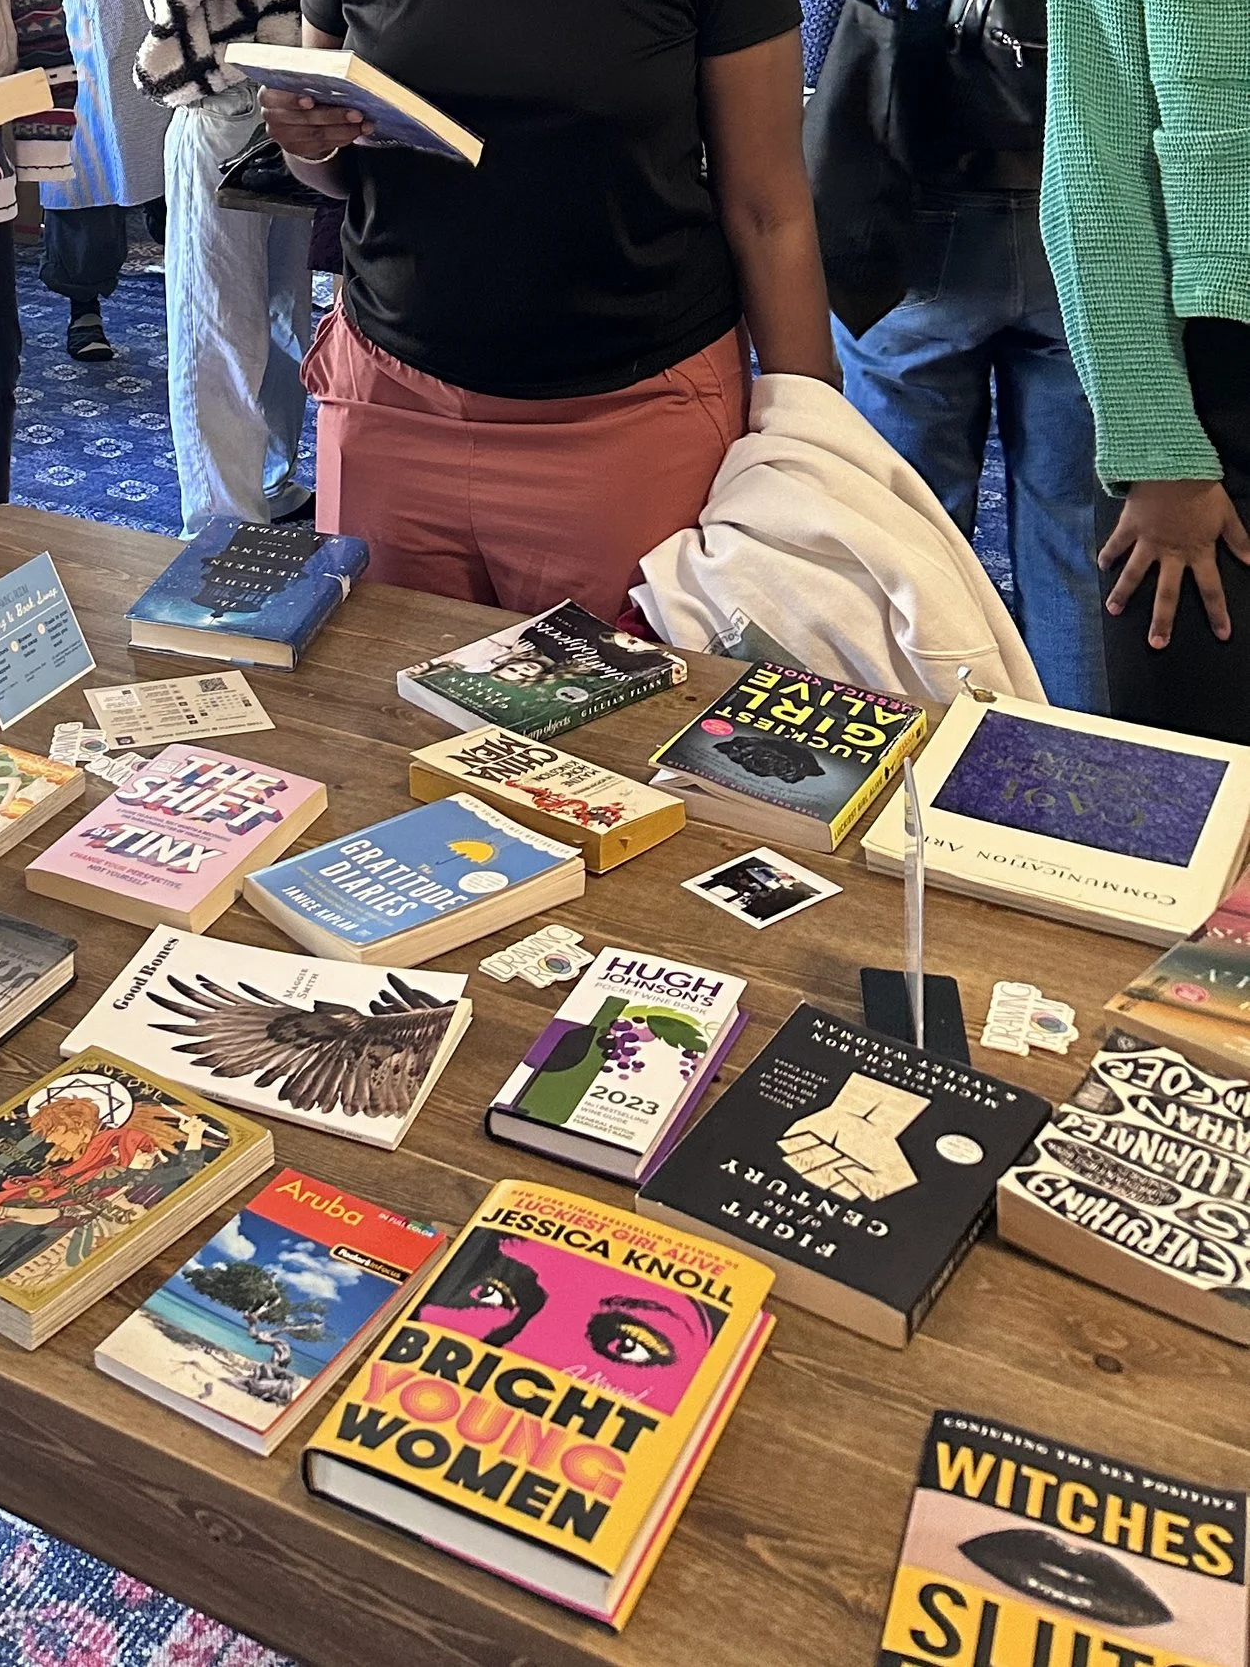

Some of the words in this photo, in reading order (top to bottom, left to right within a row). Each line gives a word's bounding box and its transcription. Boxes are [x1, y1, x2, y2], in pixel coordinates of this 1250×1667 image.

[211, 559, 299, 579] BETWEEN
[230, 545, 304, 561] OCEANS
[15, 597, 36, 617] Book
[36, 587, 59, 605] Swap
[210, 577, 272, 592] LIGHT
[534, 621, 598, 650] objects
[763, 661, 822, 686] KNOLL
[581, 694, 624, 717] GILLIAN
[630, 677, 663, 696] FLYNN
[738, 684, 887, 746] GIRL
[748, 668, 907, 725] ALIVE
[832, 681, 912, 713] JESSICA
[53, 725, 82, 764] RAWING
[543, 714, 571, 735] objects
[714, 706, 873, 764] LUCKIEST
[447, 733, 532, 769] MEN
[464, 747, 558, 784] CHINA
[533, 759, 579, 782] KINGSTON
[171, 755, 288, 804] THE
[561, 768, 602, 787] MAXINE
[115, 776, 284, 834] SHIFT
[90, 827, 113, 838] BY
[105, 823, 224, 874] TINX
[922, 835, 964, 852] ART
[69, 851, 104, 868] CHANGE
[103, 860, 127, 874] YOUR
[126, 867, 182, 890] PERSPECTIVE,
[87, 864, 105, 875] NOT
[319, 859, 419, 917] DIARIES
[340, 839, 468, 911] GRATITUDE
[977, 849, 1177, 907] COMMUNICATION
[281, 885, 317, 913] JANICE
[315, 907, 361, 932] KAPLAN
[488, 926, 573, 975] DRAWING
[524, 943, 587, 983] ROOM
[112, 973, 148, 1011] Good
[144, 936, 180, 977] Bones
[283, 967, 308, 999] MAGGIE
[298, 973, 319, 1000] SMITH
[598, 972, 715, 1007] JOHNSON'S
[605, 957, 724, 997] HUGH
[594, 982, 639, 999] POCKET
[641, 992, 671, 1005] WINE
[673, 1001, 706, 1015] BOOK
[987, 984, 1032, 1046] DRAWING
[813, 1017, 909, 1062] WALDMAN
[902, 1065, 1000, 1109] MICHAEL
[918, 1059, 997, 1094] AYELET
[1005, 1092, 1018, 1103] &
[1105, 1058, 1215, 1105] FOER
[580, 1106, 600, 1117] WINE
[601, 1111, 628, 1125] GUIDE
[589, 1085, 660, 1116] 2023
[598, 1105, 649, 1125] BESTSELLING
[1137, 1096, 1250, 1158] ATHAN
[275, 1179, 365, 1226] Aruba
[719, 1158, 890, 1238] CENTURY
[378, 1212, 389, 1221] IN
[388, 1216, 407, 1229] FULL
[406, 1222, 435, 1238] COLOR
[511, 1189, 534, 1198] NEW
[537, 1195, 565, 1207] YORK
[567, 1203, 599, 1216] TIMES
[602, 1214, 672, 1245] BESTSELLING
[676, 1241, 721, 1261] AUTHOR
[724, 1259, 739, 1269] OF
[514, 1197, 612, 1235] LUCKIEST
[611, 1228, 659, 1254] GIRL
[662, 1245, 726, 1277] ALIVE
[721, 1200, 839, 1259] FIGHT
[481, 1208, 610, 1259] JESSICA
[621, 1249, 735, 1307] KNOLL
[380, 1325, 660, 1453] BRIGHT
[362, 1361, 627, 1502] YOUNG
[336, 1402, 612, 1543] WOMEN
[943, 1416, 1049, 1455] CONJURING
[1056, 1448, 1094, 1469] THE
[1100, 1463, 1135, 1484] SEX
[1142, 1477, 1238, 1512] POSITIVE
[937, 1441, 1236, 1578] WITCHES
[909, 1583, 1199, 1667] SLUT
